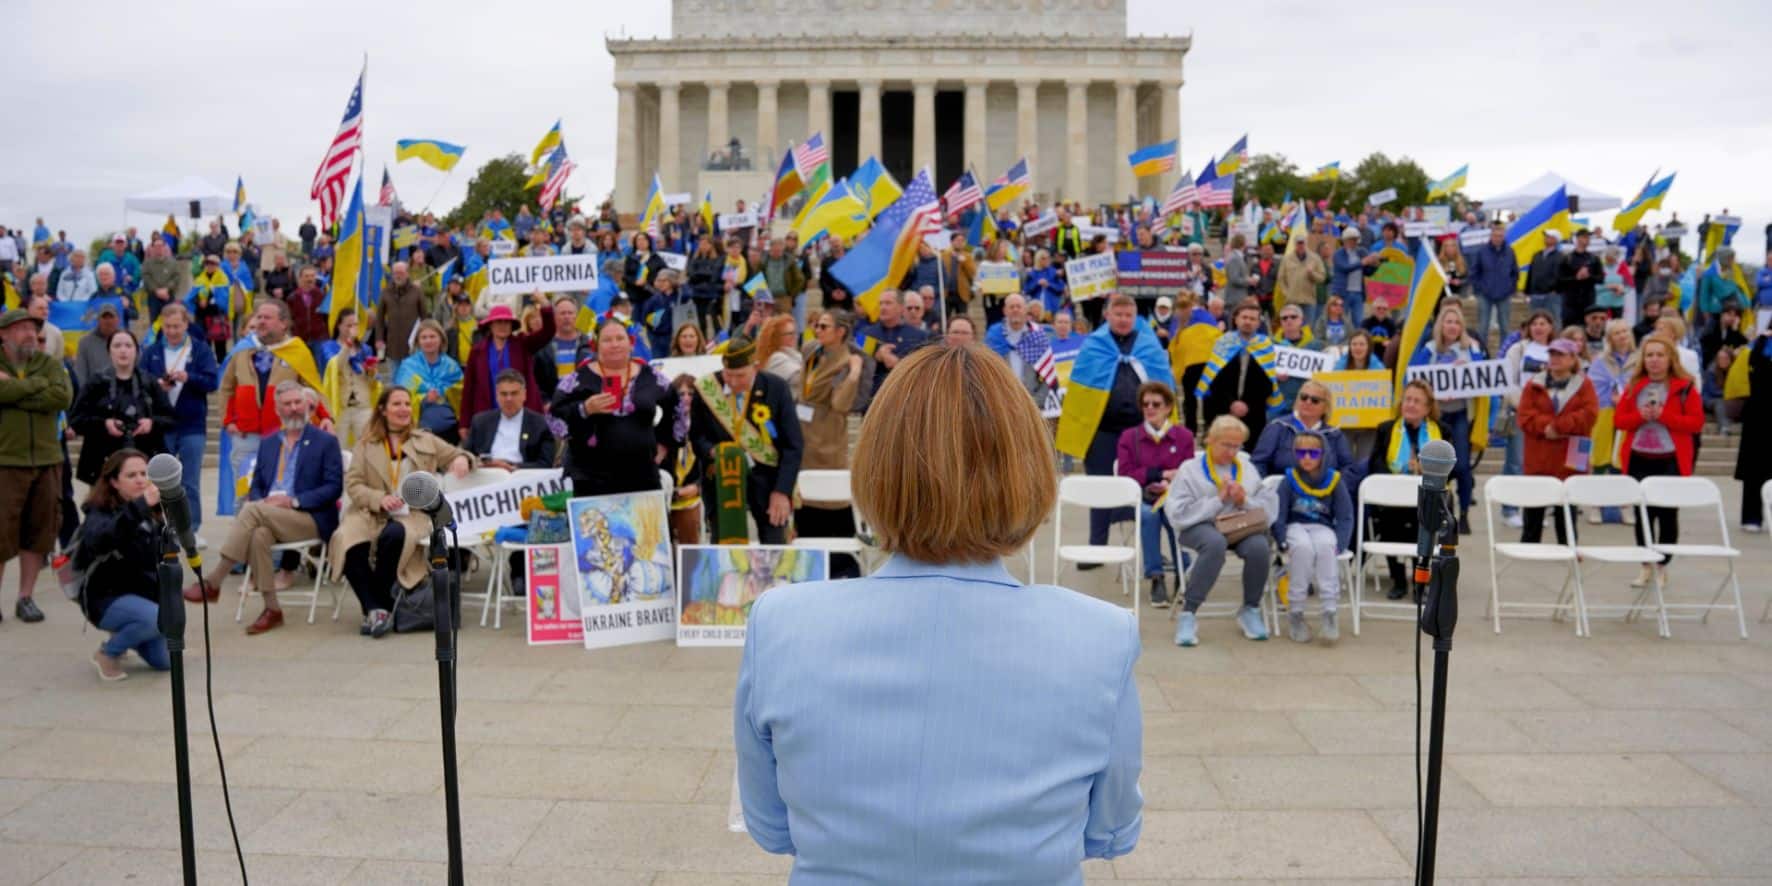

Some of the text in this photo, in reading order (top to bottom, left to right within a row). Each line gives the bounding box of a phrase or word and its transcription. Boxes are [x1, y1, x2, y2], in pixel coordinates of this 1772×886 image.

[492, 263, 595, 285] CALIFORNIA
[1277, 351, 1324, 373] EGON
[1335, 395, 1391, 409] RAINE
[584, 611, 633, 633] UKRAINE
[636, 606, 675, 626] BRAVE!
